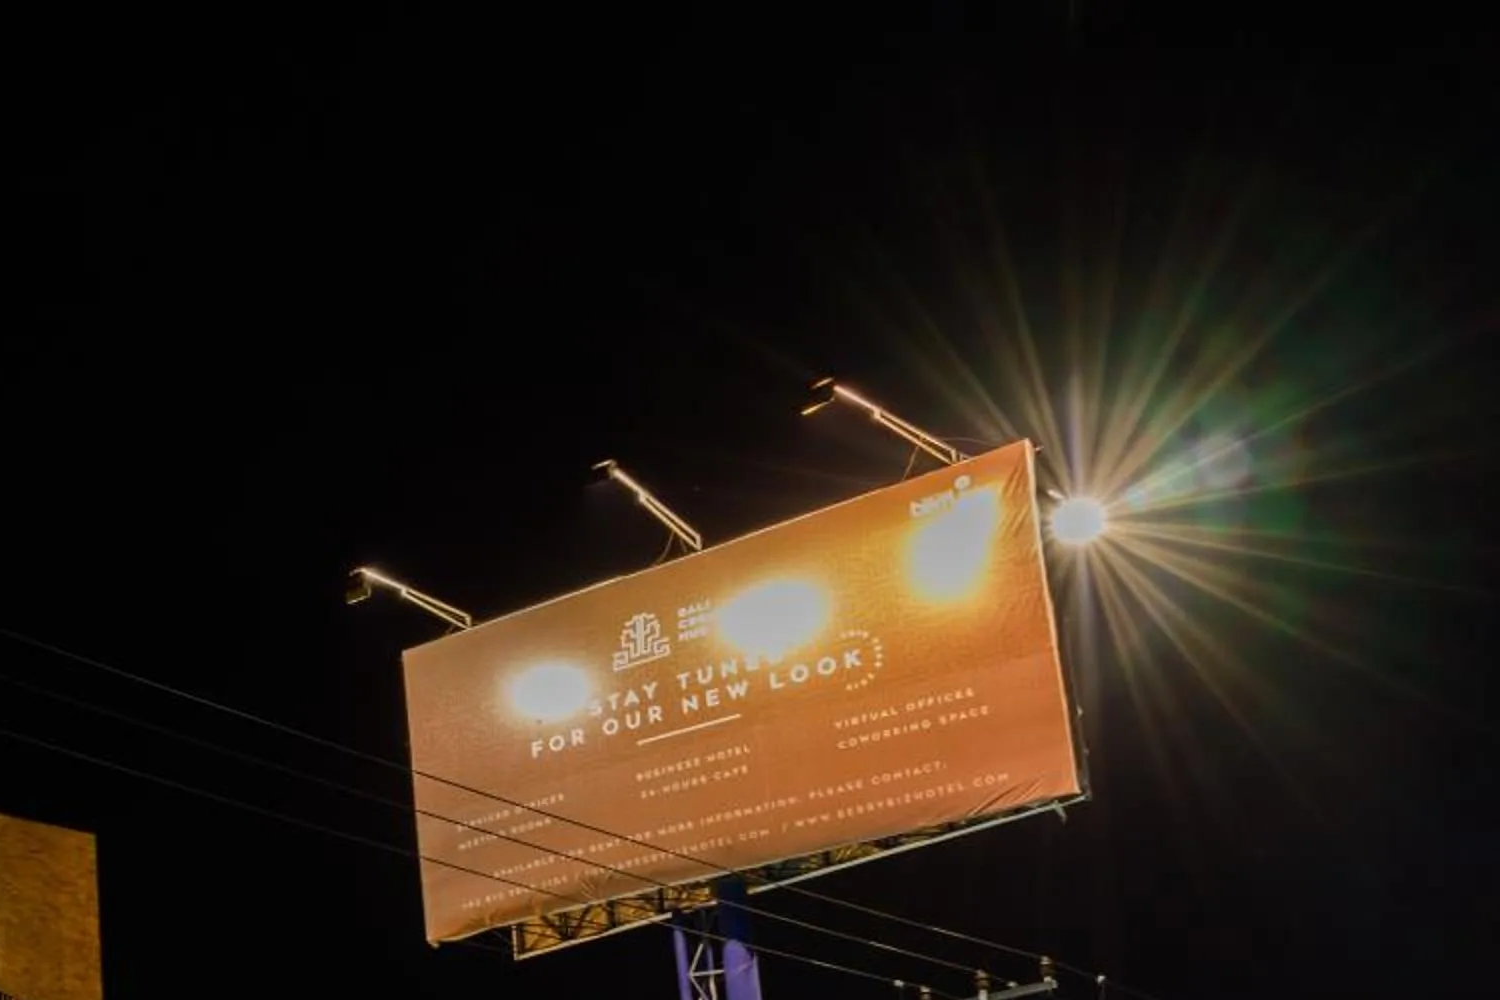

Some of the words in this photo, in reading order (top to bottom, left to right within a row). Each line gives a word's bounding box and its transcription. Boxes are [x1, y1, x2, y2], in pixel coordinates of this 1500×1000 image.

[531, 728, 585, 759] FOR
[602, 705, 663, 736] OUR
[681, 679, 749, 715] NEW
[769, 648, 862, 690] LOOK
[589, 682, 658, 718] STAY
[677, 648, 785, 690] TUN
[835, 706, 898, 730] VIRTUAL
[836, 719, 932, 750] COWORKING
[939, 704, 990, 727] SPACE
[705, 744, 751, 763] HOTEL
